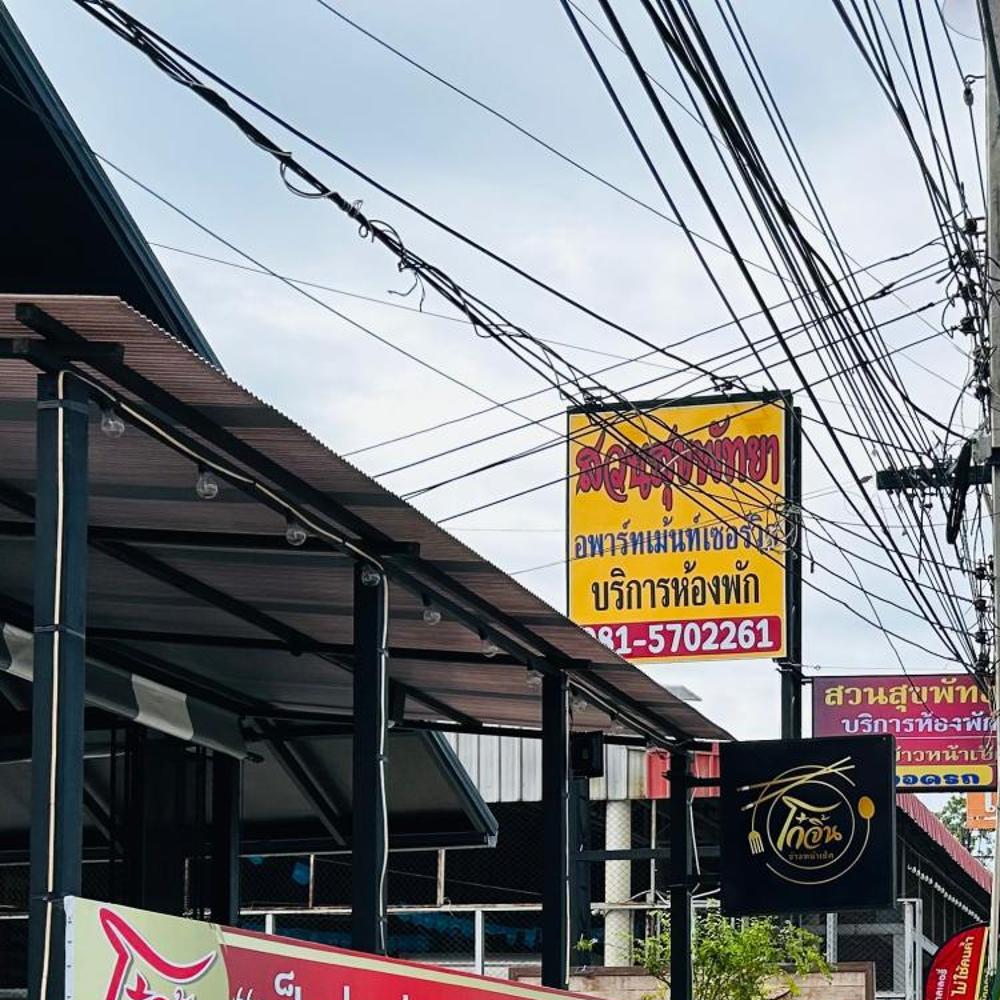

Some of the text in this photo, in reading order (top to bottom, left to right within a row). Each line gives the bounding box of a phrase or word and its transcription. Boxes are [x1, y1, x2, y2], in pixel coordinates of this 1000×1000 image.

[592, 560, 760, 611] บริการห้องพัก
